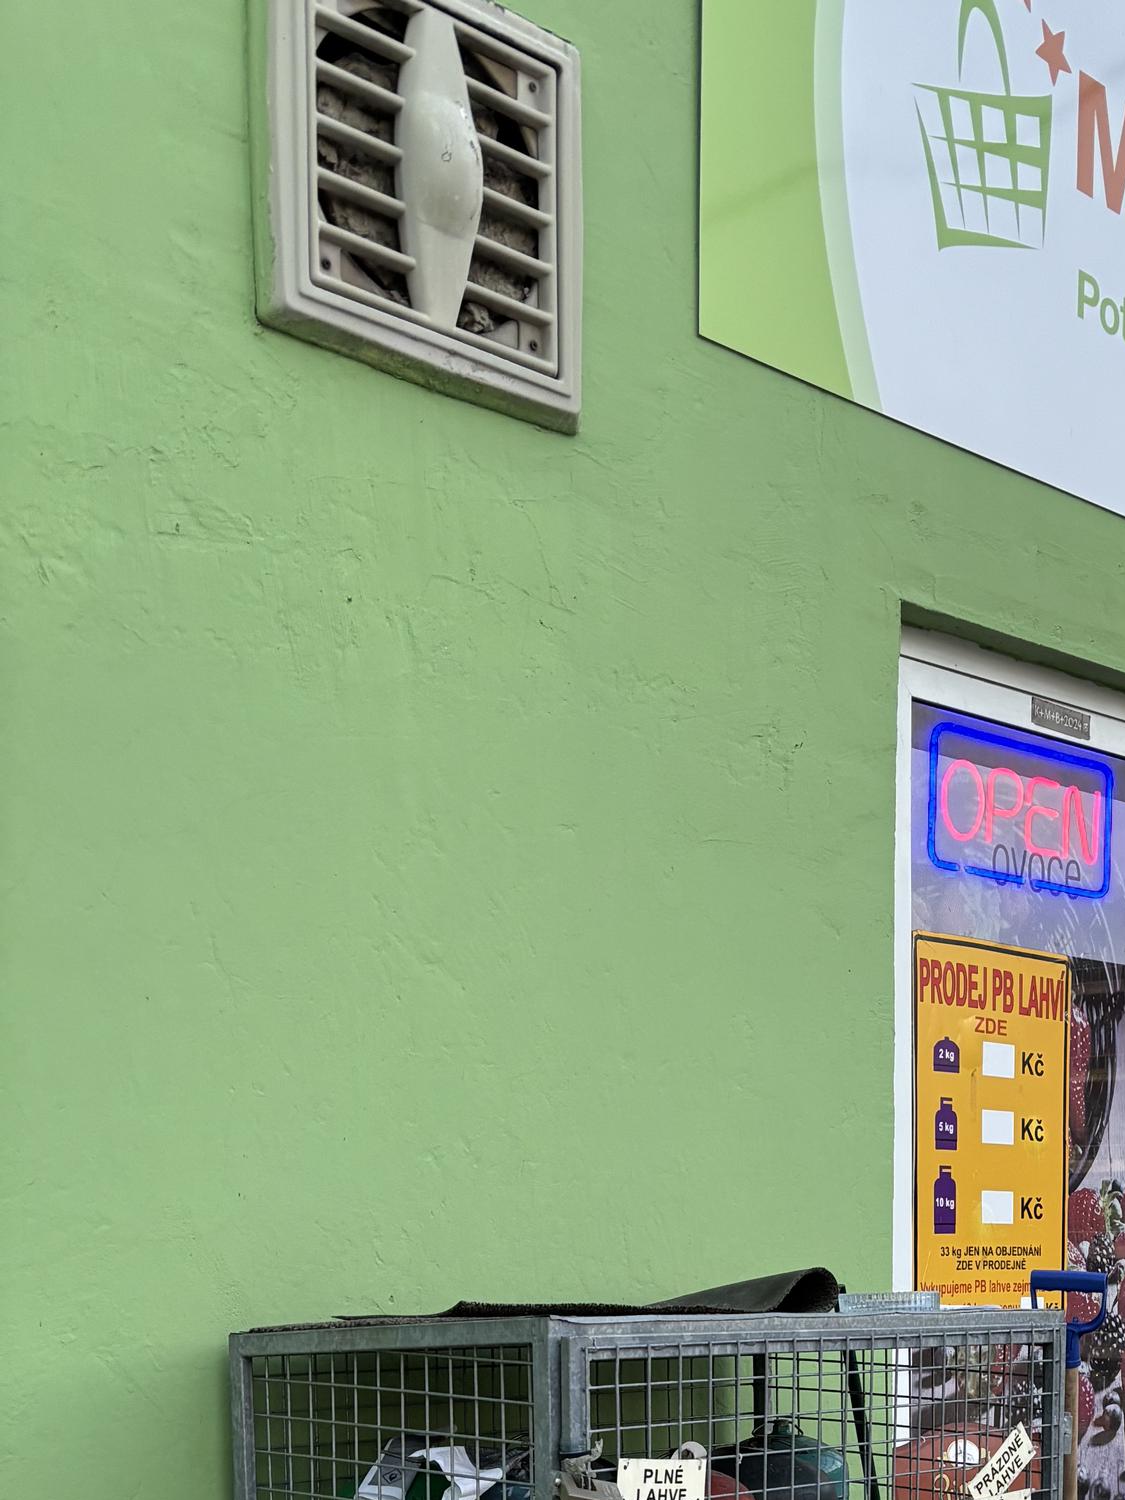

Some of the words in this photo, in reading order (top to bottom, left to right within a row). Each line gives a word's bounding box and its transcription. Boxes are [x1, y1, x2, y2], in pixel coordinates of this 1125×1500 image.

[940, 759, 1102, 866] OPEN
[919, 957, 988, 1010] PRODEJ
[992, 968, 1015, 1014] PB
[1018, 970, 1066, 1022] LAHVÍ
[974, 1016, 1008, 1036] ZDE
[938, 1048, 944, 1059] 2
[945, 1048, 955, 1061] kg
[1021, 1051, 1044, 1077] Kč
[938, 1121, 944, 1132] 5
[944, 1121, 954, 1134] kg
[1021, 1117, 1044, 1142] Kč
[935, 1197, 944, 1207] 10
[945, 1197, 955, 1210] kg
[1020, 1197, 1044, 1220] Kč
[940, 1246, 950, 1257] 33
[951, 1246, 962, 1259] kg
[963, 1246, 980, 1257] JEN
[981, 1246, 994, 1257] NA
[995, 1245, 1042, 1257] OBJEDNÁNÍ
[956, 1260, 973, 1271] ZDE
[975, 1260, 981, 1270] V
[982, 1259, 1027, 1271] PRODEJNĚ
[920, 1281, 972, 1298] Vykupujeme
[974, 1279, 987, 1293] PB
[989, 1279, 1011, 1293] lahve
[1013, 1280, 1031, 1295] zejm
[643, 1464, 684, 1484] PLNÉ
[975, 1433, 1024, 1495] PRÁZDNÉ
[988, 1455, 1023, 1497] LAHVE
